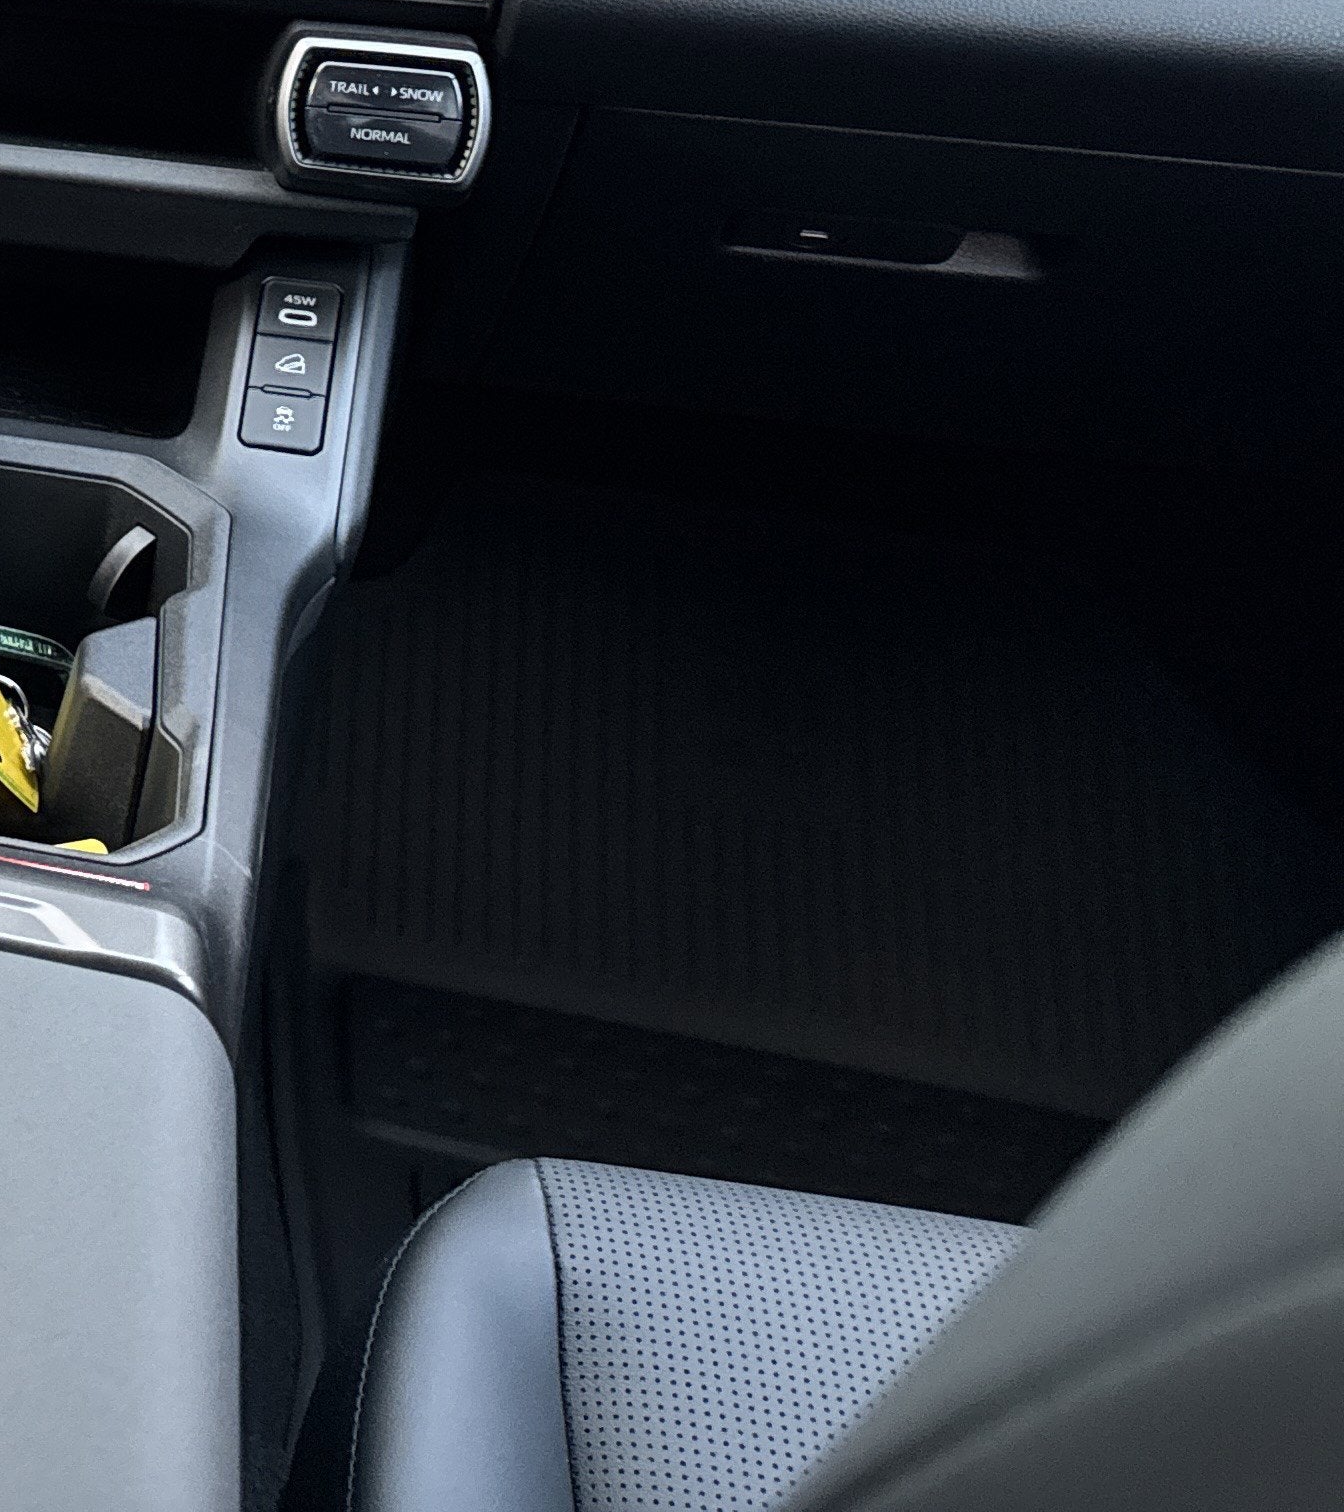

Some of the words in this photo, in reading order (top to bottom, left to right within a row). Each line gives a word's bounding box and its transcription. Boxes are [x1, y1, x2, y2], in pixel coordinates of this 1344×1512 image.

[329, 80, 370, 96] TRAIL
[399, 86, 443, 102] SNOW
[349, 127, 411, 145] NORMAL
[283, 293, 317, 307] 45W
